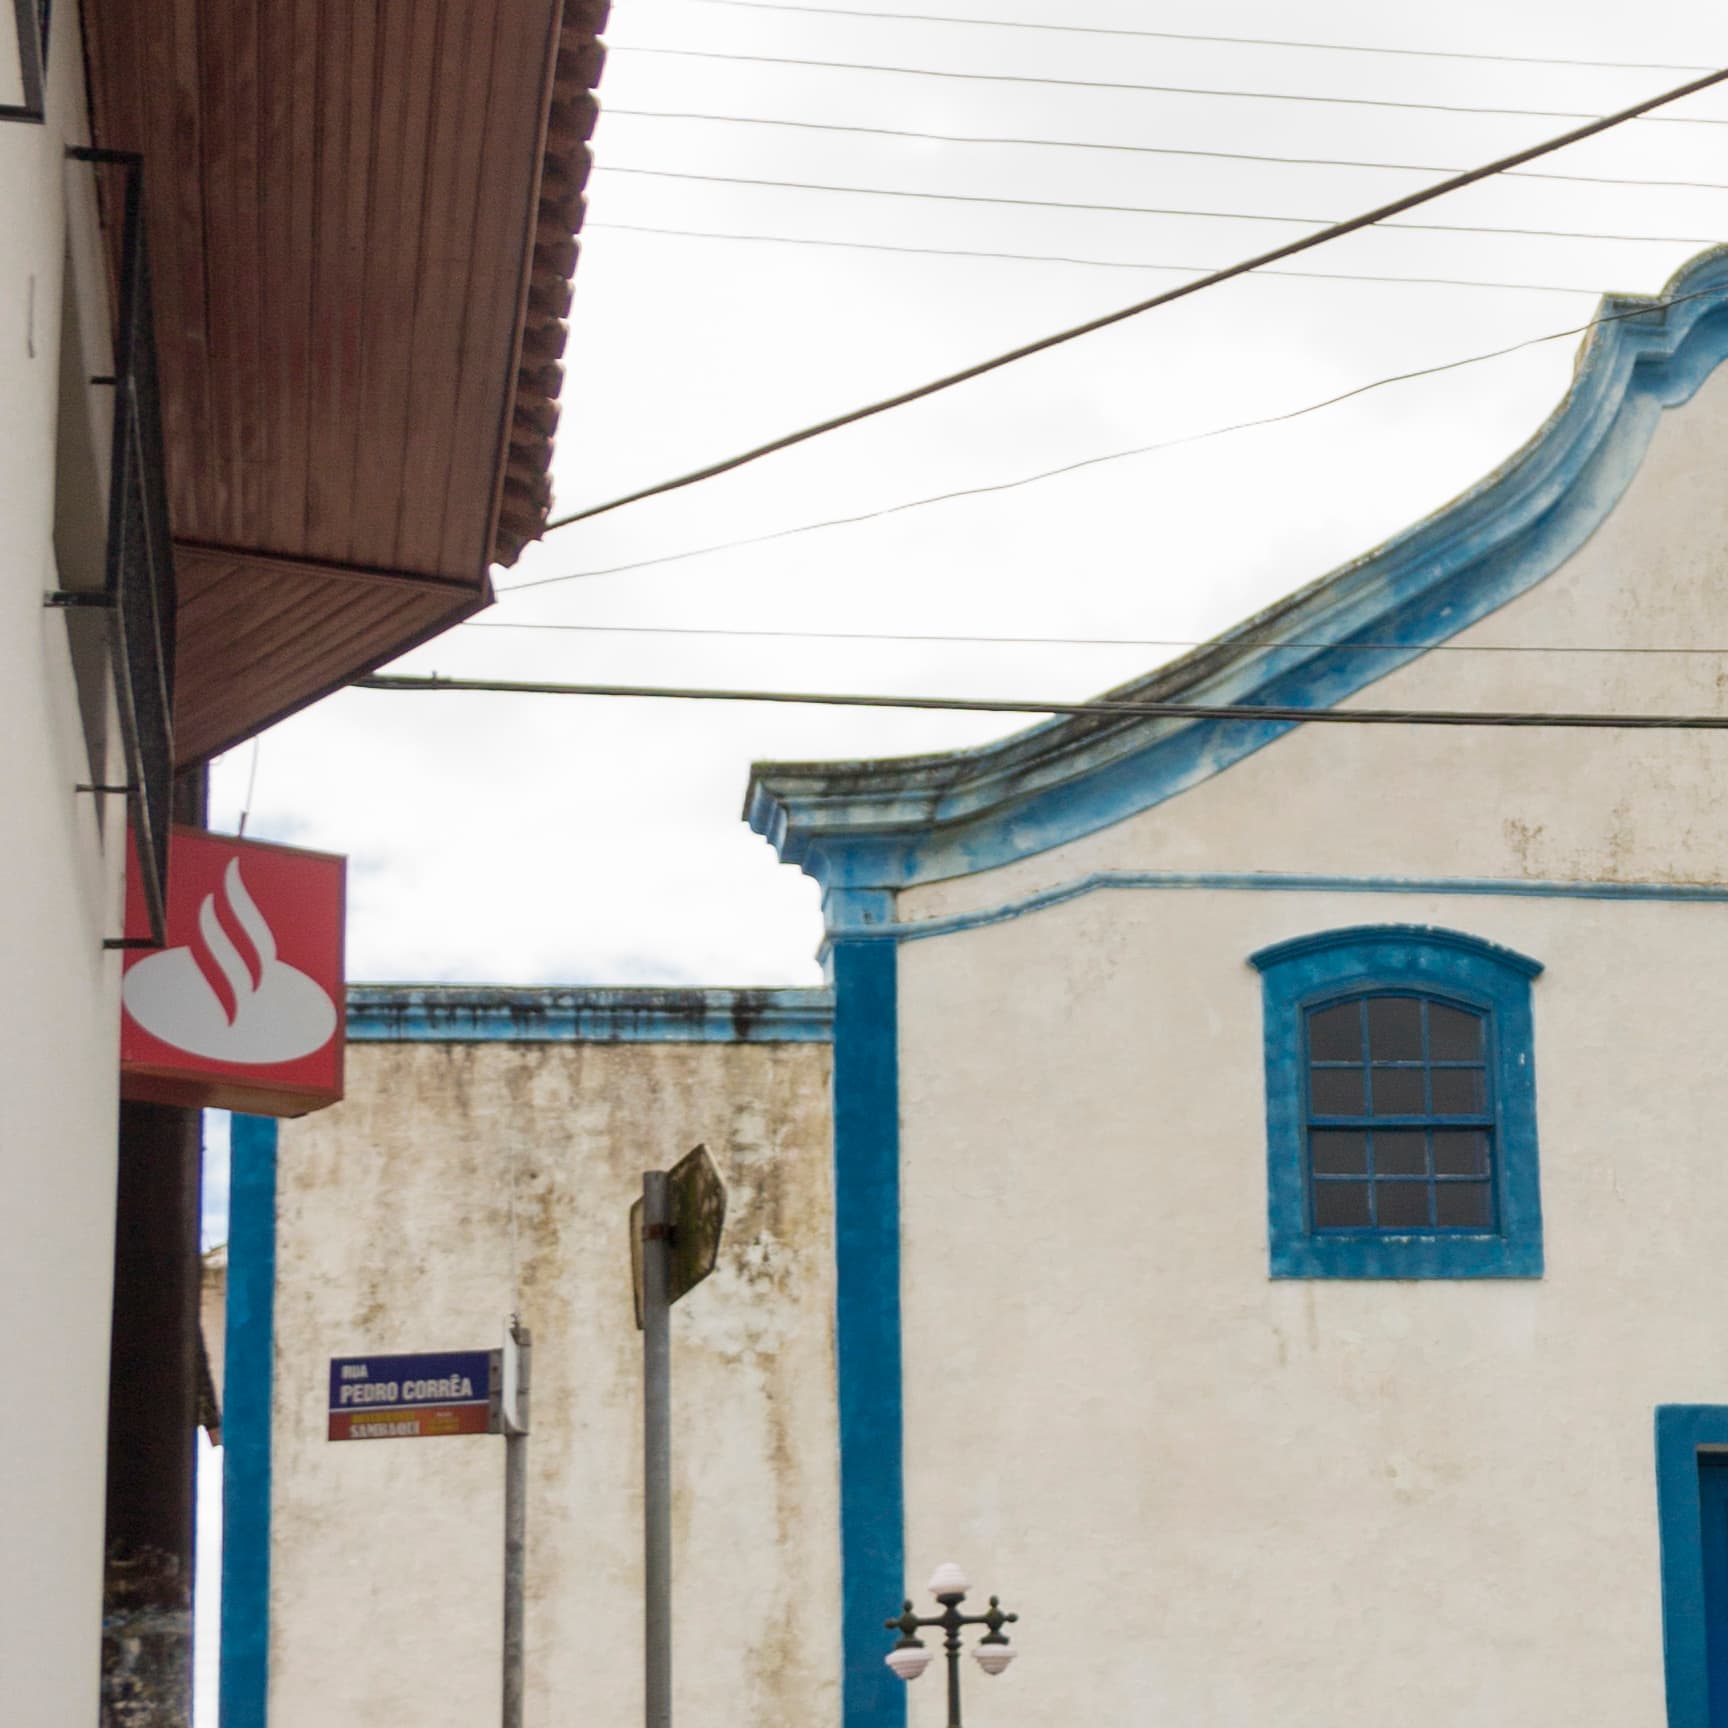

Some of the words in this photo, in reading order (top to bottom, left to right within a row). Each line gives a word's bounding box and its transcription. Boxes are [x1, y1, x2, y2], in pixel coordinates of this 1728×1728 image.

[341, 1364, 368, 1380] RUA
[340, 1381, 398, 1404] PEDRO
[402, 1373, 473, 1400] CORRÊA
